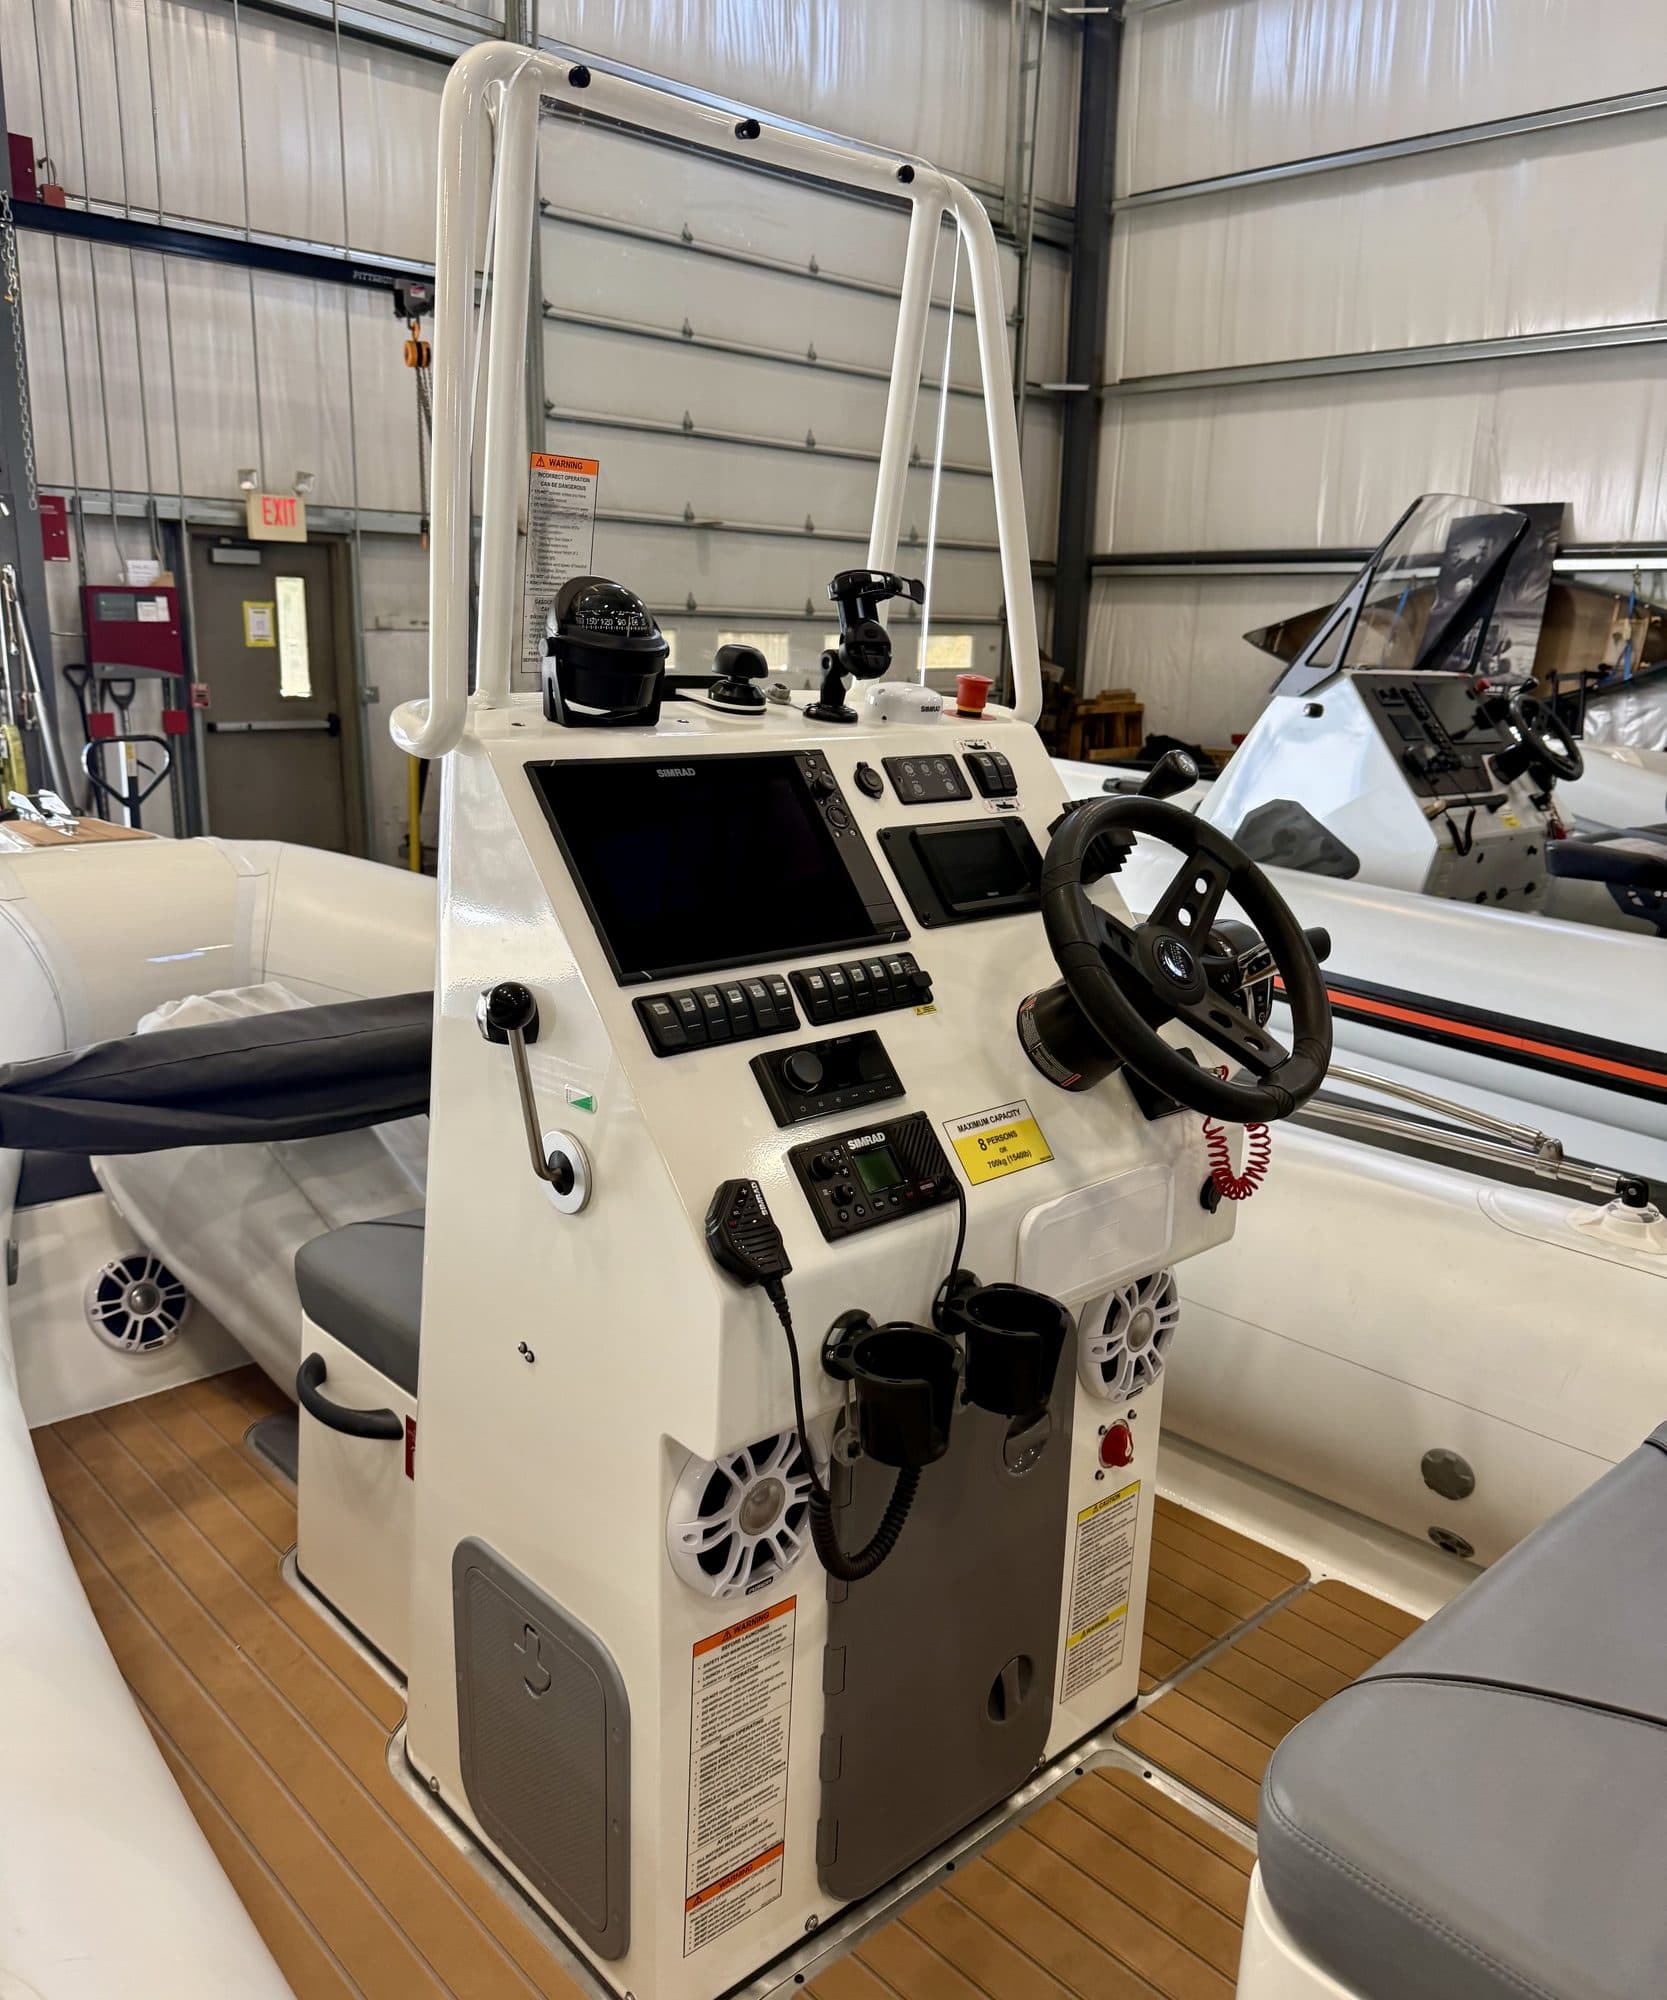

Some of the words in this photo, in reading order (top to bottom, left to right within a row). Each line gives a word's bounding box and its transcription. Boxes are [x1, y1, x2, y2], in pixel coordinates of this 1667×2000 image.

[549, 458, 583, 470] WARNING
[538, 472, 564, 480] INCORRECT
[565, 475, 591, 483] OPERATION
[558, 483, 587, 491] DANGEROUS
[262, 496, 296, 528] EXIT
[656, 767, 696, 778] SIMRAD
[957, 1118, 990, 1133] MAXIMUM
[989, 1107, 1021, 1123] CAPACITY
[847, 1132, 886, 1150] SIMRAD
[977, 1138, 987, 1151] 8
[987, 1130, 1018, 1146] PERSONS
[999, 1146, 1008, 1154] OR
[987, 1157, 1008, 1169] 700kg
[751, 1181, 769, 1216] SIMRAD
[1099, 1493, 1121, 1509] CAUTION
[734, 1610, 769, 1634] WARNING
[721, 1637, 740, 1651] BEFORE
[742, 1623, 769, 1641] LAUNCHING
[703, 1657, 719, 1669] SAFETY
[720, 1652, 729, 1660] AND
[730, 1637, 759, 1655] MAINTENANCE
[729, 1663, 758, 1683] OPERATION
[735, 1717, 763, 1736] OPERATING
[716, 1831, 733, 1845] AFTER
[734, 1823, 748, 1835] EACH
[749, 1817, 758, 1826] USE
[719, 1863, 753, 1889] WARNING
